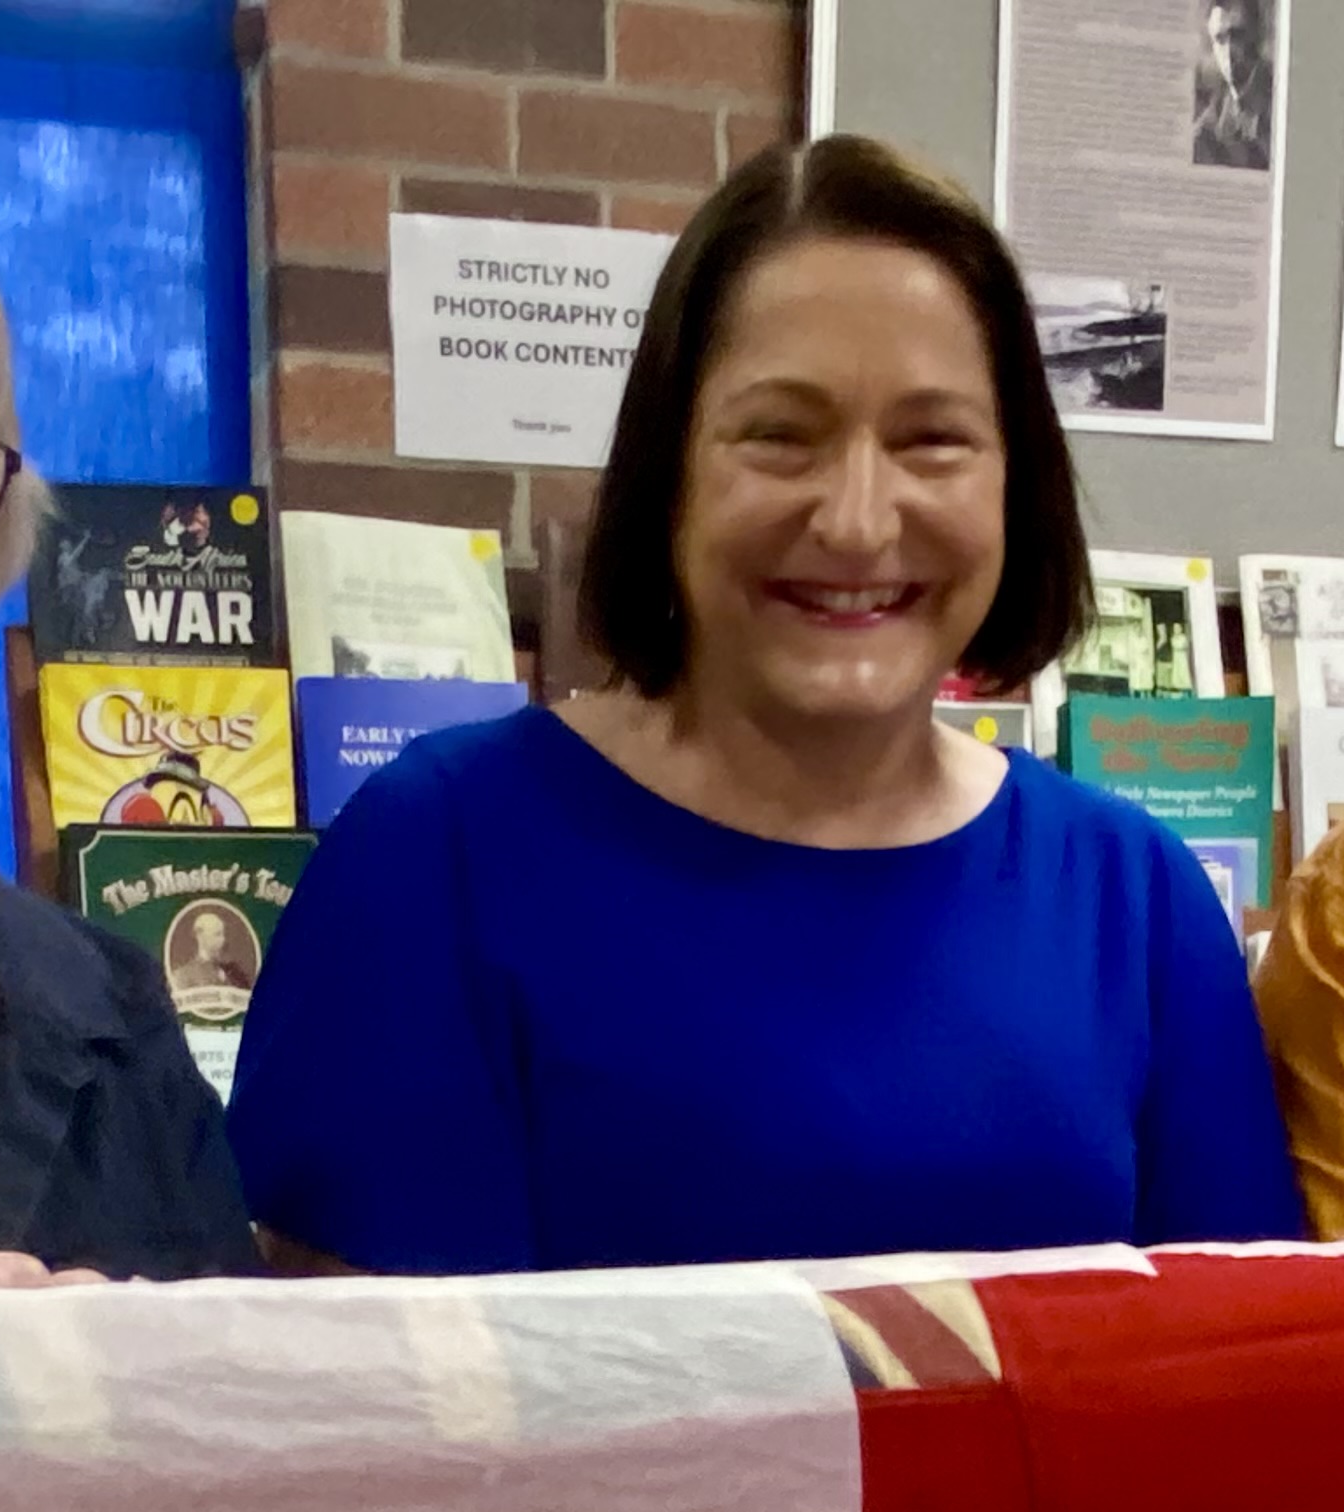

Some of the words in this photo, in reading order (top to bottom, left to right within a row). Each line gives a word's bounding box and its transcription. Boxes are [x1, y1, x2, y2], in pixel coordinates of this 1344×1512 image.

[458, 258, 568, 287] STRICTLY
[574, 268, 610, 289] NO
[433, 295, 616, 326] PHOTOGRAPHY
[623, 308, 647, 329] O
[439, 337, 508, 361] BOOK
[125, 545, 183, 569] South
[124, 589, 254, 645] WAR
[149, 695, 177, 712] The
[342, 725, 404, 745] EARLY
[102, 878, 150, 916] The
[148, 862, 251, 899] Master's
[253, 867, 294, 907] Tou
